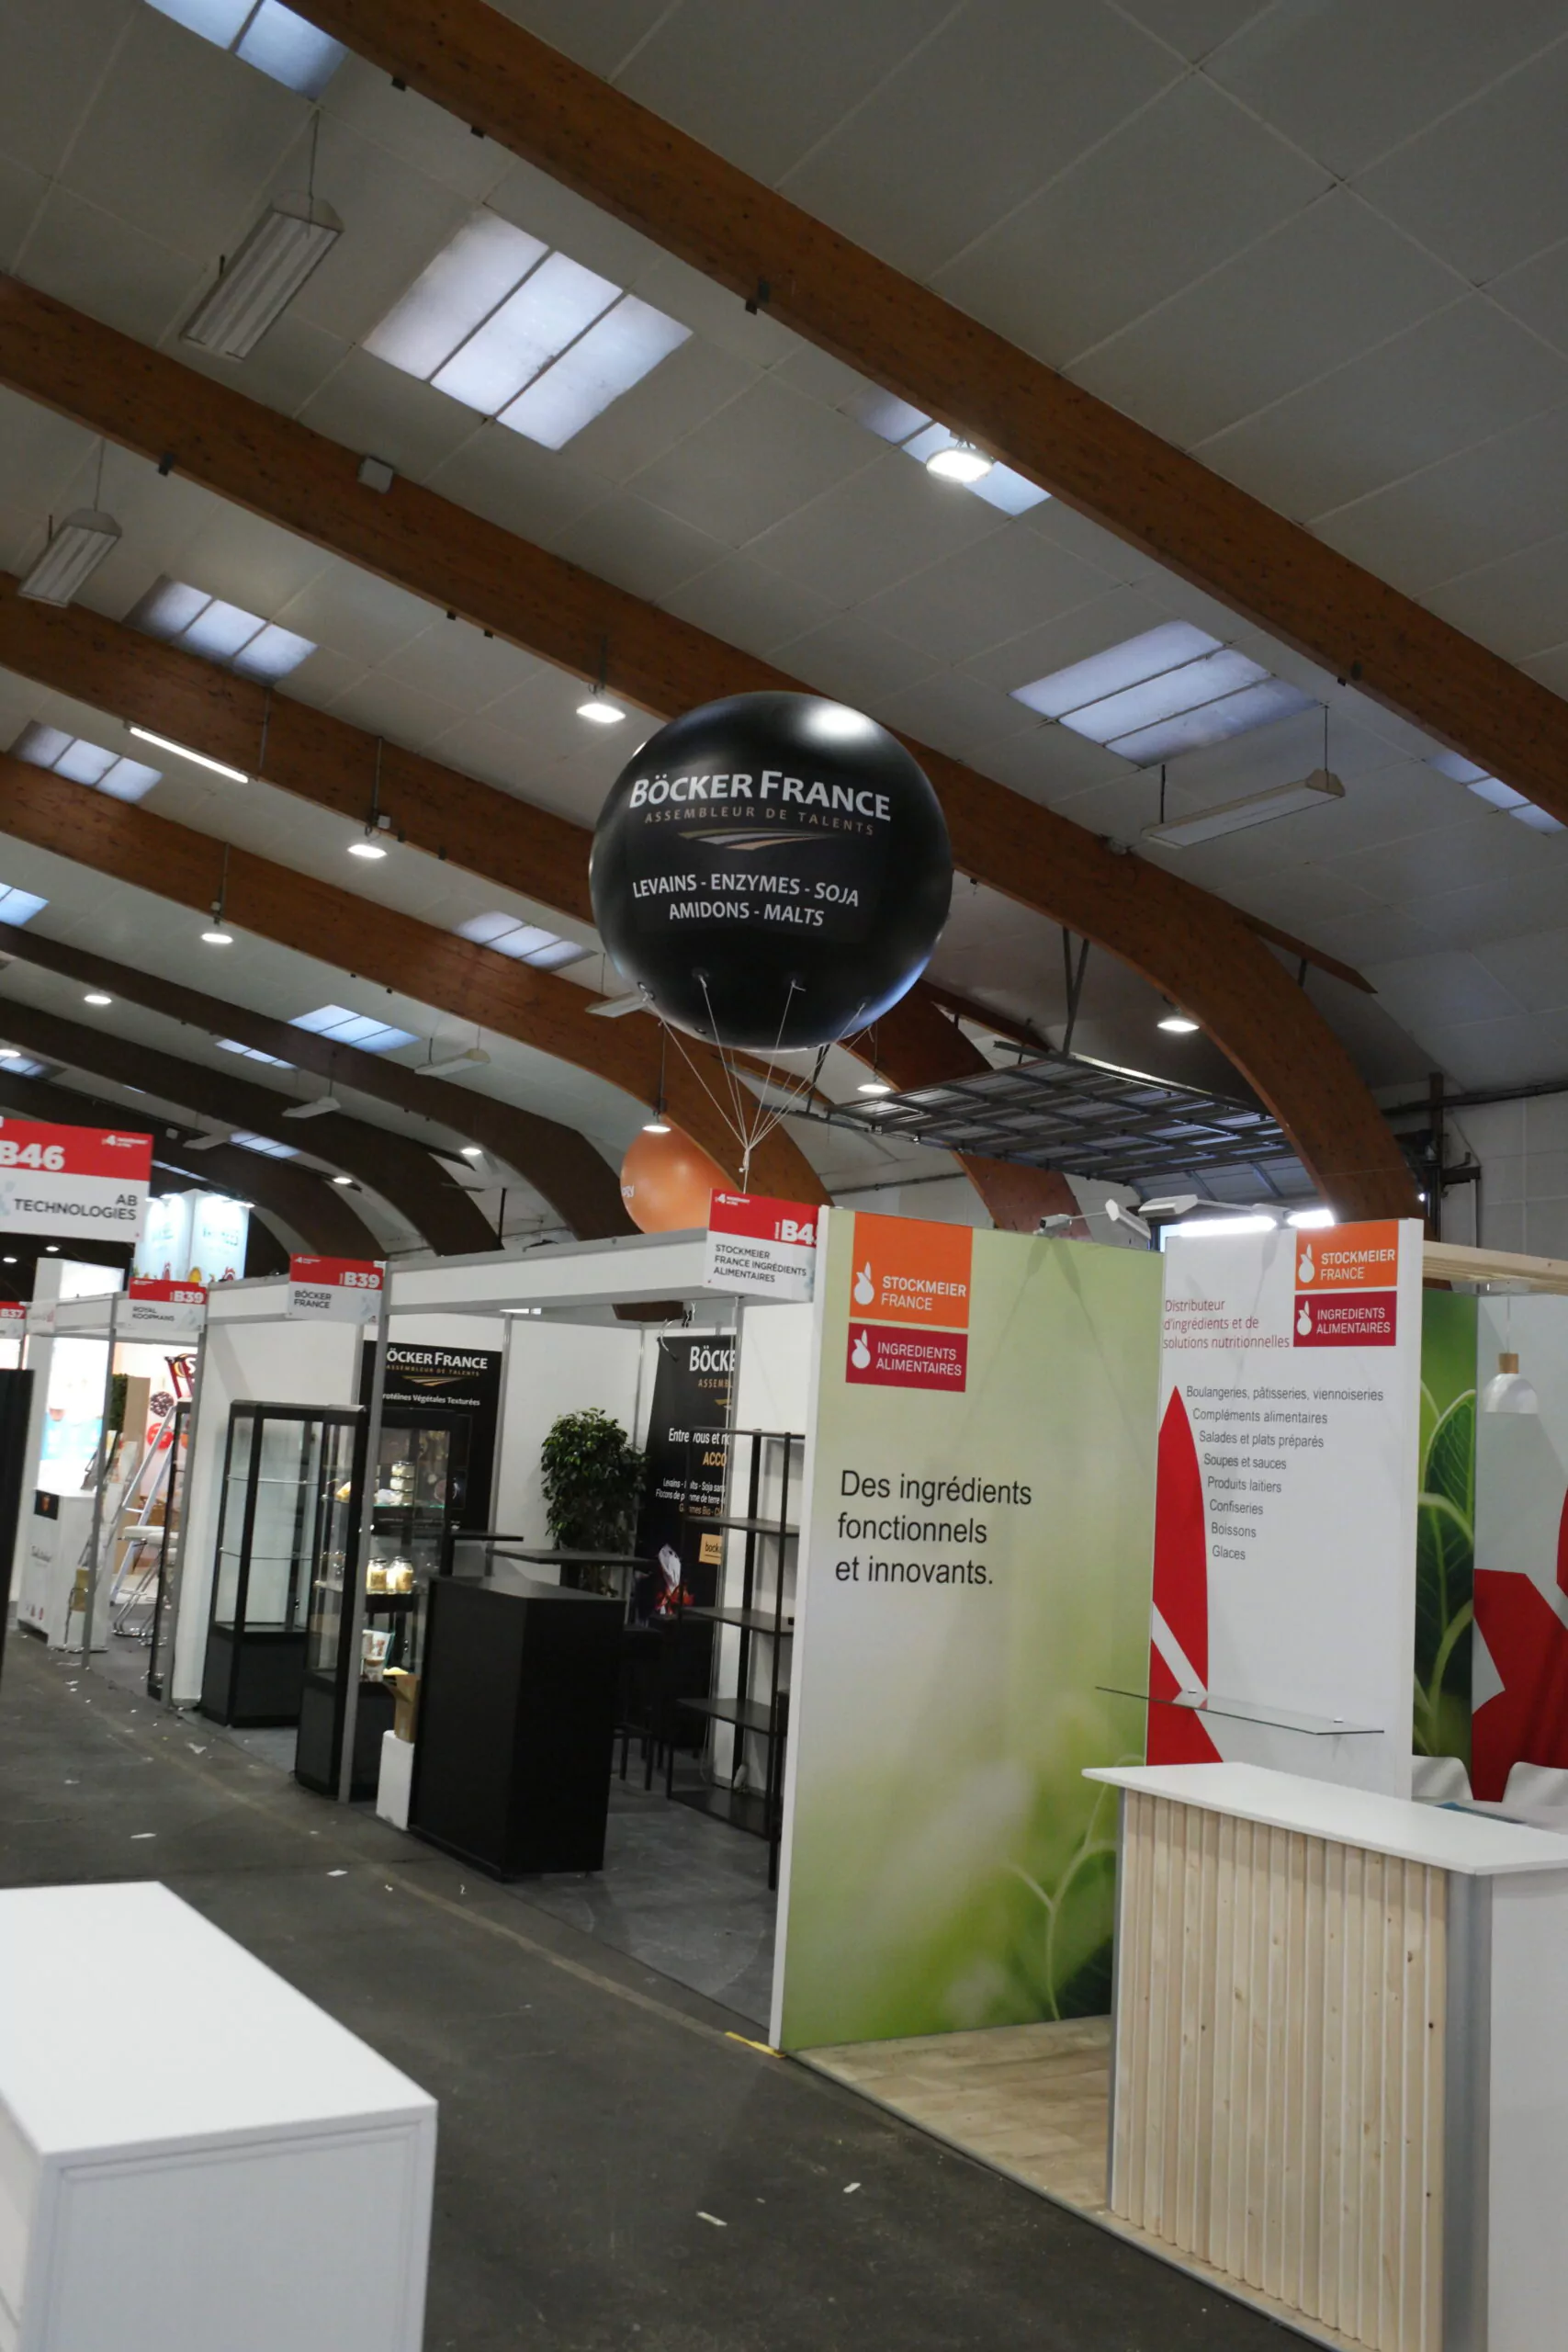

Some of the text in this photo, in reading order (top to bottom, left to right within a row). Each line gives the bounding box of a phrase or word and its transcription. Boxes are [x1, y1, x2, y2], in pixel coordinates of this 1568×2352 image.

[629, 771, 891, 821] BÖCKER FRANCE
[645, 807, 874, 836] ASSEMBLEUR DE TALENTS
[633, 874, 697, 899] LEVAINS
[711, 874, 800, 896] ENZYMES
[815, 883, 859, 908] SOJA
[669, 901, 750, 920] AMIDONS
[763, 904, 824, 927] MALTS
[0, 1140, 65, 1170] B46
[116, 1194, 138, 1206] AB
[14, 1198, 137, 1221] TECHNOLOGIES
[781, 1219, 816, 1245] B4
[716, 1244, 771, 1260] STOCKMEIER
[1321, 1249, 1395, 1266] STOCKMEIER
[714, 1255, 807, 1277] FRANCE INGRÉDIENTS
[1320, 1267, 1364, 1281] FRANCE
[344, 1272, 379, 1289] B39
[713, 1267, 775, 1283] ALIMENTAIRES
[882, 1275, 967, 1297] STOCKMEIER
[294, 1298, 331, 1309] FRANCE
[881, 1293, 933, 1311] FRANCE
[1165, 1299, 1225, 1312] Distributeur
[1317, 1307, 1385, 1321] INGREDIENTS
[1164, 1316, 1259, 1334] d'ingrédients et de
[1316, 1321, 1391, 1335] ALIMENTAIRES
[877, 1341, 957, 1361] INGREDIENTS
[1163, 1335, 1291, 1350] solutions nutritionnelles
[387, 1348, 488, 1369] ÖCKER FRANCE
[689, 1345, 735, 1372] BÖCKE
[875, 1358, 963, 1377] ALIMENTAIRES
[698, 1379, 732, 1388] ASSEMB
[382, 1392, 412, 1402] rotéines
[1186, 1385, 1383, 1402] Boulangeries, pâtisseries, viennoiseries
[1192, 1408, 1328, 1425] Compléments alimentaires
[668, 1428, 690, 1442] Entre
[711, 1433, 720, 1445] et
[1199, 1430, 1324, 1449] Salades et plats préparés
[703, 1452, 727, 1467] ACCO
[1204, 1453, 1287, 1470] Soupes et sauces
[840, 1470, 1032, 1507] Des ingrédients
[1208, 1476, 1281, 1493] Produits laitiers
[1210, 1499, 1264, 1515] Confiseries
[838, 1512, 987, 1544] fonctionnels
[1211, 1522, 1257, 1538] Boissons
[705, 1540, 721, 1553] bock
[1213, 1545, 1247, 1560] Glaces
[835, 1555, 993, 1585] et innovants.
